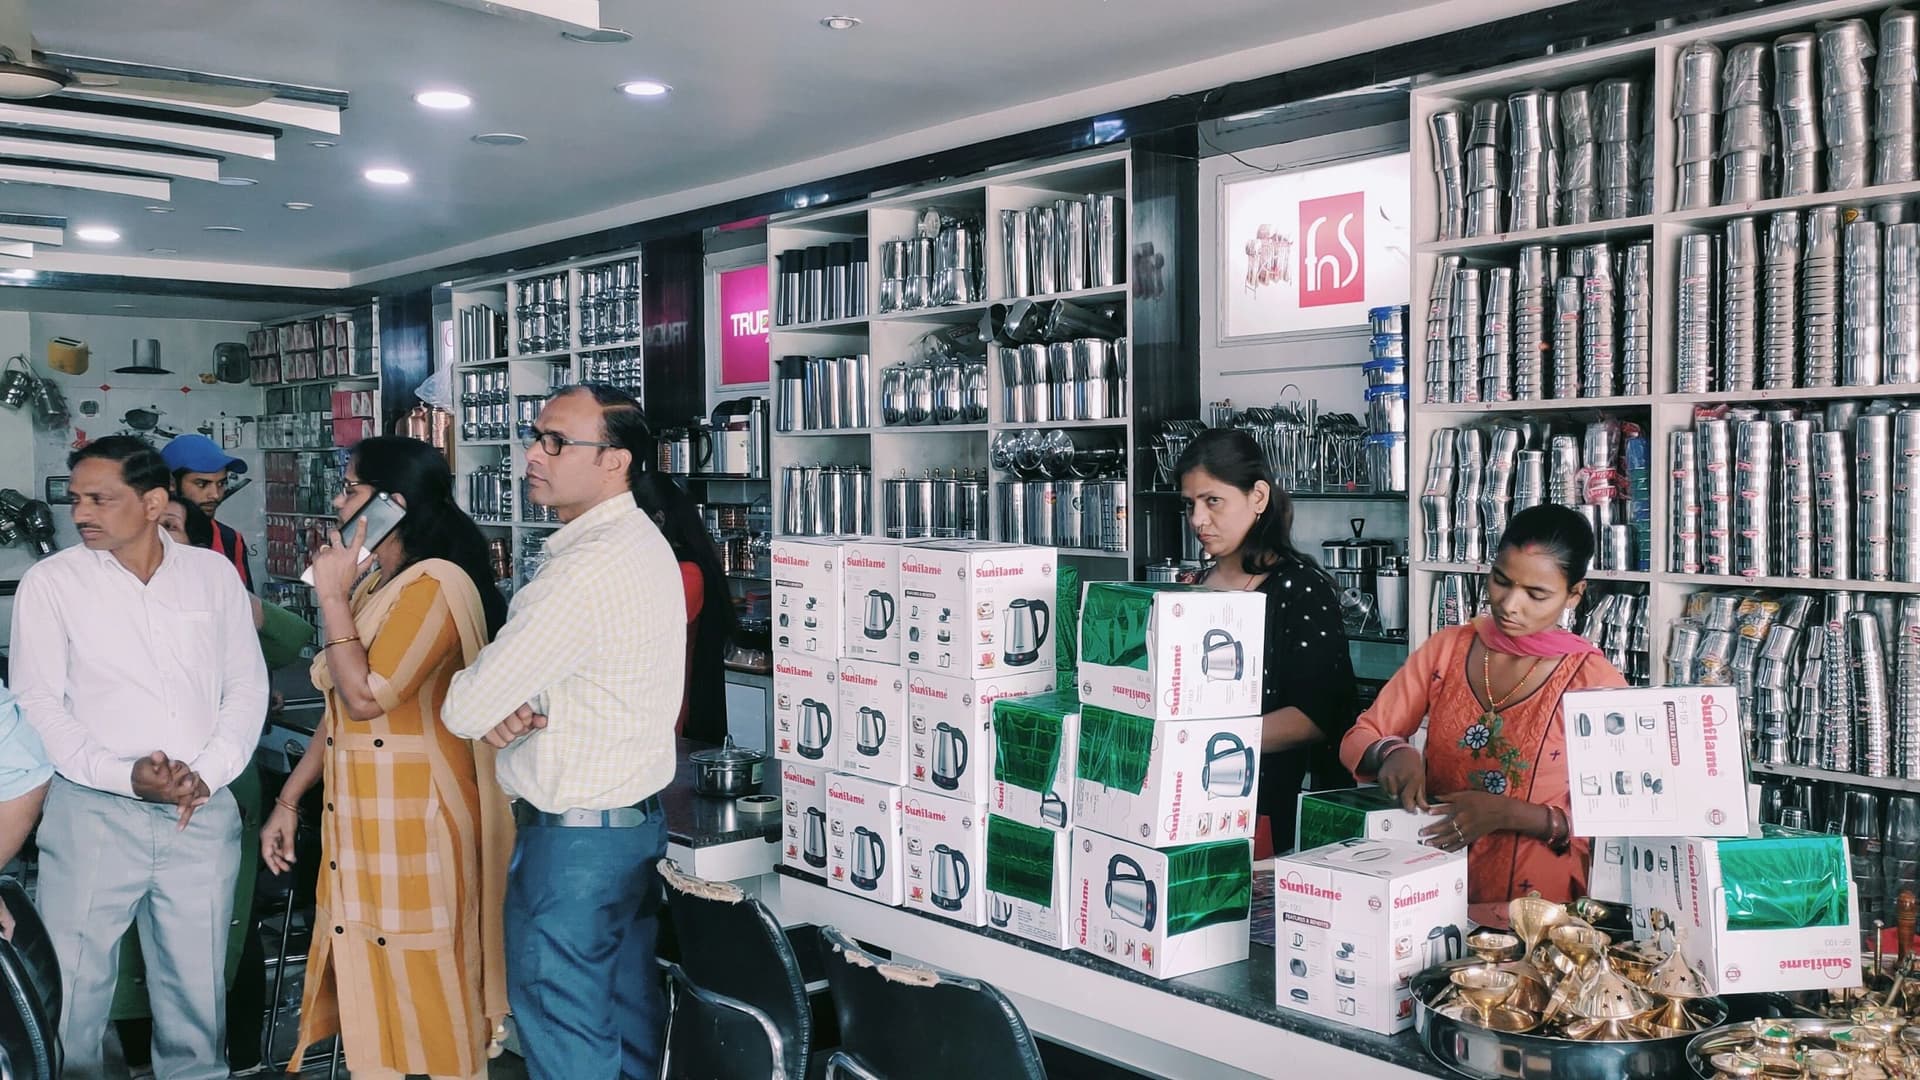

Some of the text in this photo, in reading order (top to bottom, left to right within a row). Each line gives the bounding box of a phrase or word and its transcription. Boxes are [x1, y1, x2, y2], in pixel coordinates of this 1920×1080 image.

[1700, 693, 1719, 778] Sunflame
[1279, 878, 1343, 902] Sunflame
[1393, 888, 1440, 910] Sunflame
[1778, 957, 1853, 970] Sunflame
